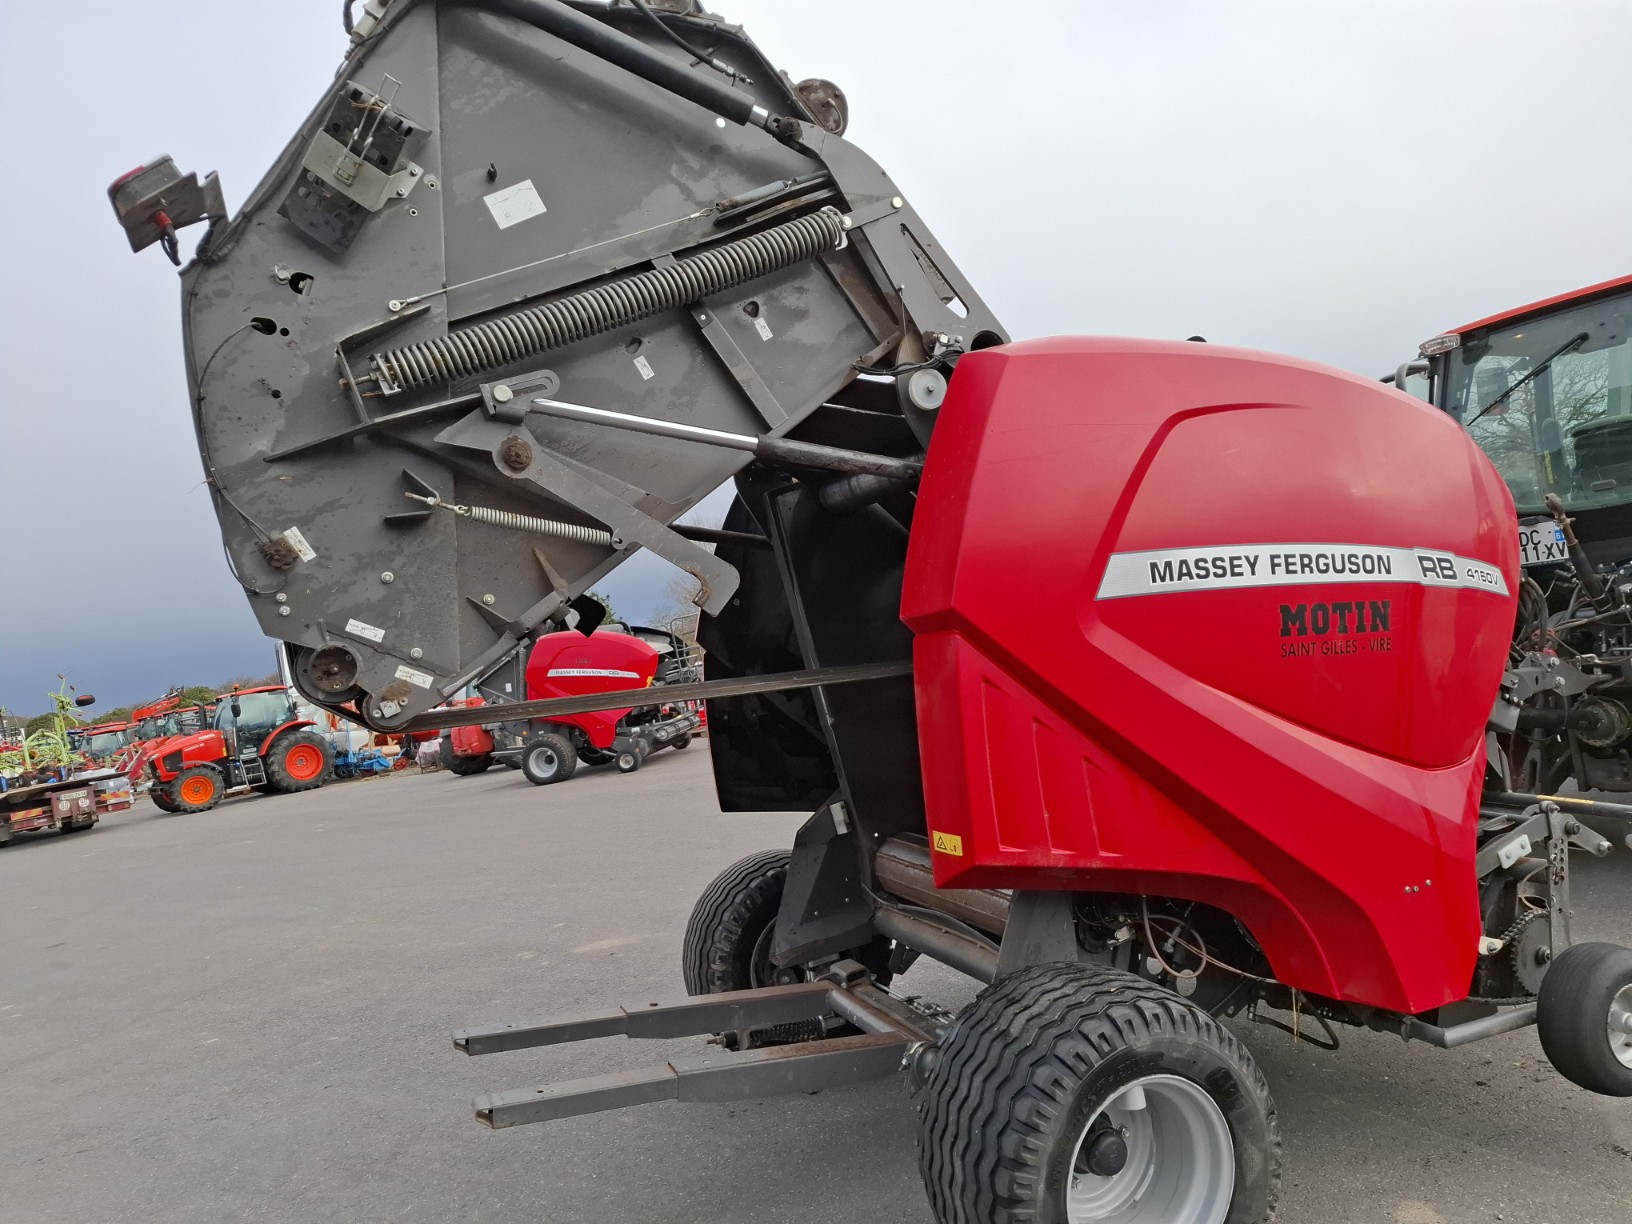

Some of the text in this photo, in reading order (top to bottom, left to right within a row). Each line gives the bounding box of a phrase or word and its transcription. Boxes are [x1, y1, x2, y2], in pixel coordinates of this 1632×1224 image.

[1149, 553, 1498, 586] MASSEY FERGUSON RB 4160V
[1279, 600, 1391, 637] MOTIN
[1281, 641, 1317, 658] SAINT
[1321, 640, 1358, 656] GILLES
[1369, 638, 1392, 652] VIRE
